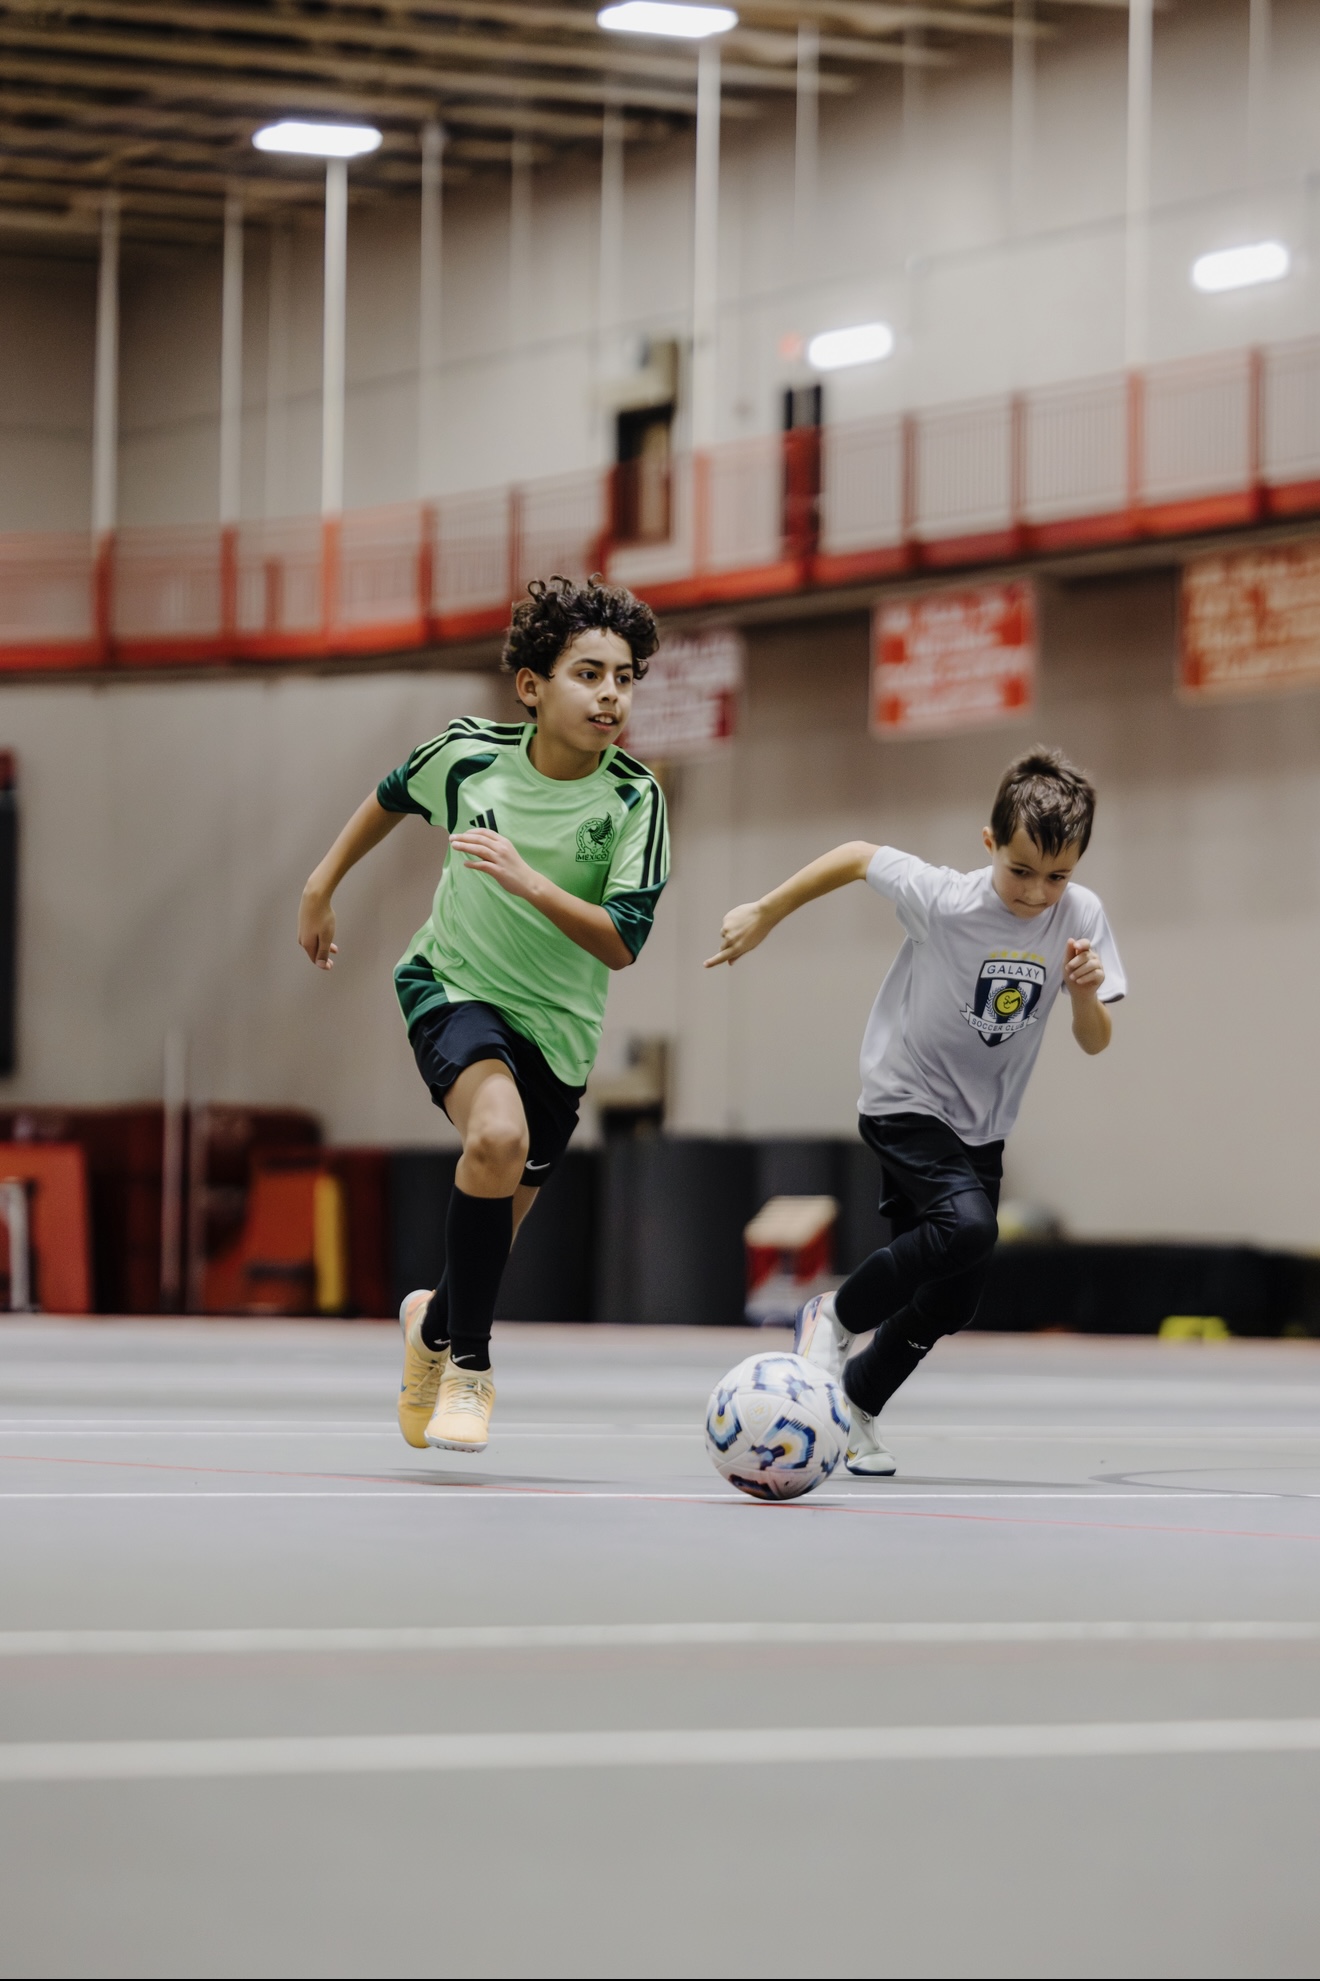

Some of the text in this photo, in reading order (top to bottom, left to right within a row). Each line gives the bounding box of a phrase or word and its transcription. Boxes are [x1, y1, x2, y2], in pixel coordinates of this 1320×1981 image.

[987, 964, 1040, 980] GALAXY
[971, 1018, 1025, 1032] SOCCER CLUB
